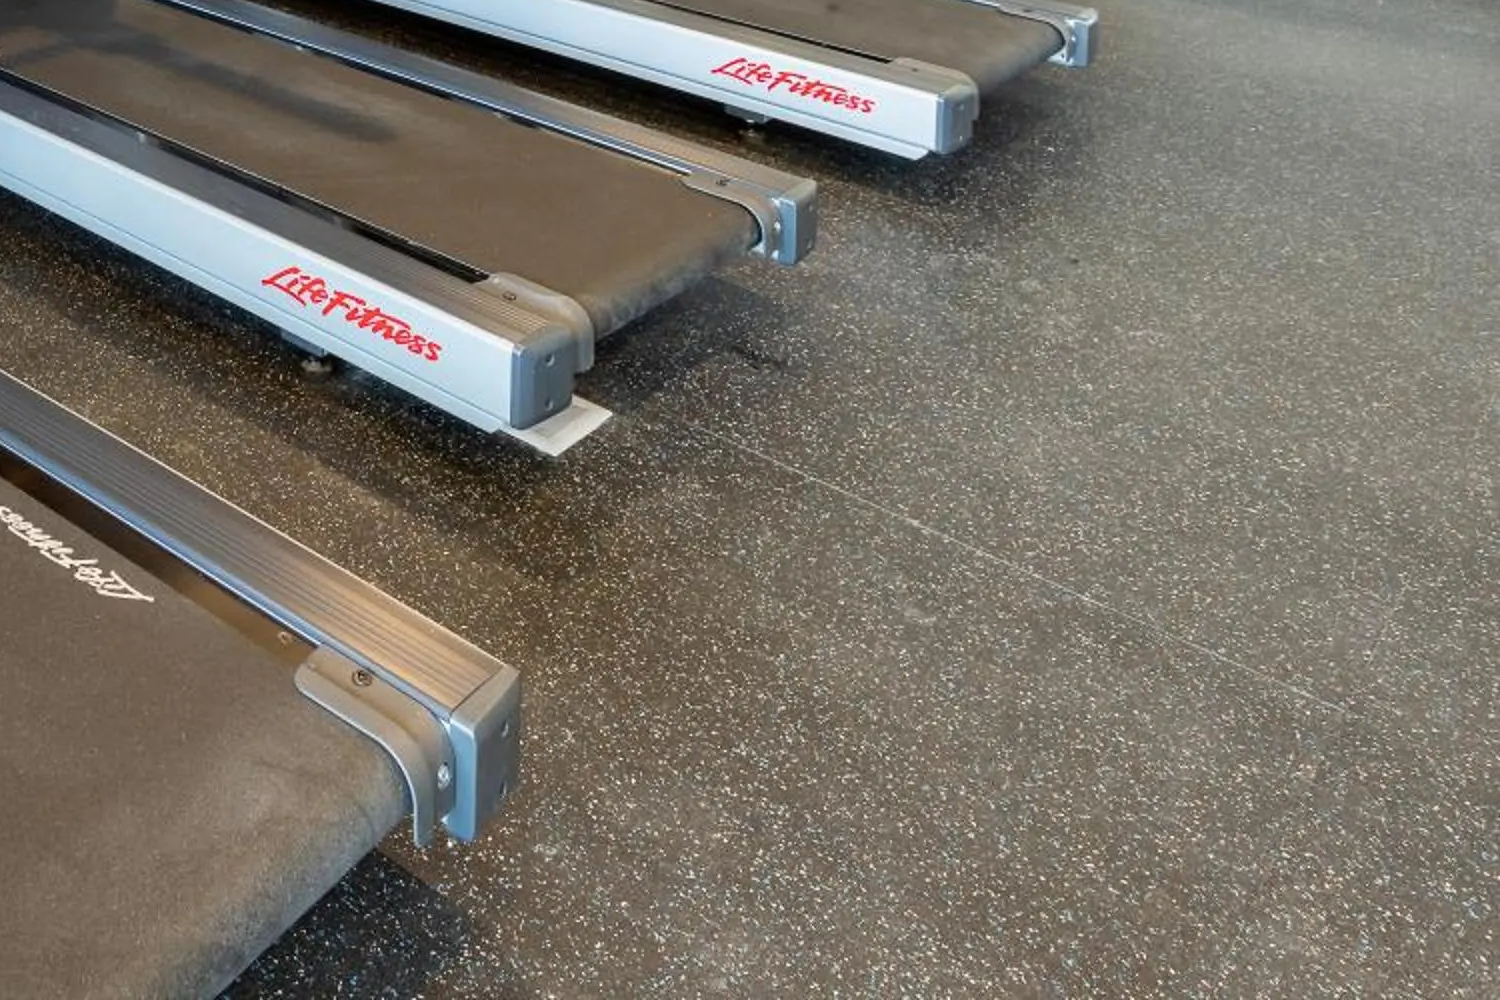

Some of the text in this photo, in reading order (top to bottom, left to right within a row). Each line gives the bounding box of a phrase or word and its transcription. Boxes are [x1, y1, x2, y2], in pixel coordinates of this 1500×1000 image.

[711, 57, 877, 113] Life Fitness
[261, 266, 443, 362] Life Fitness
